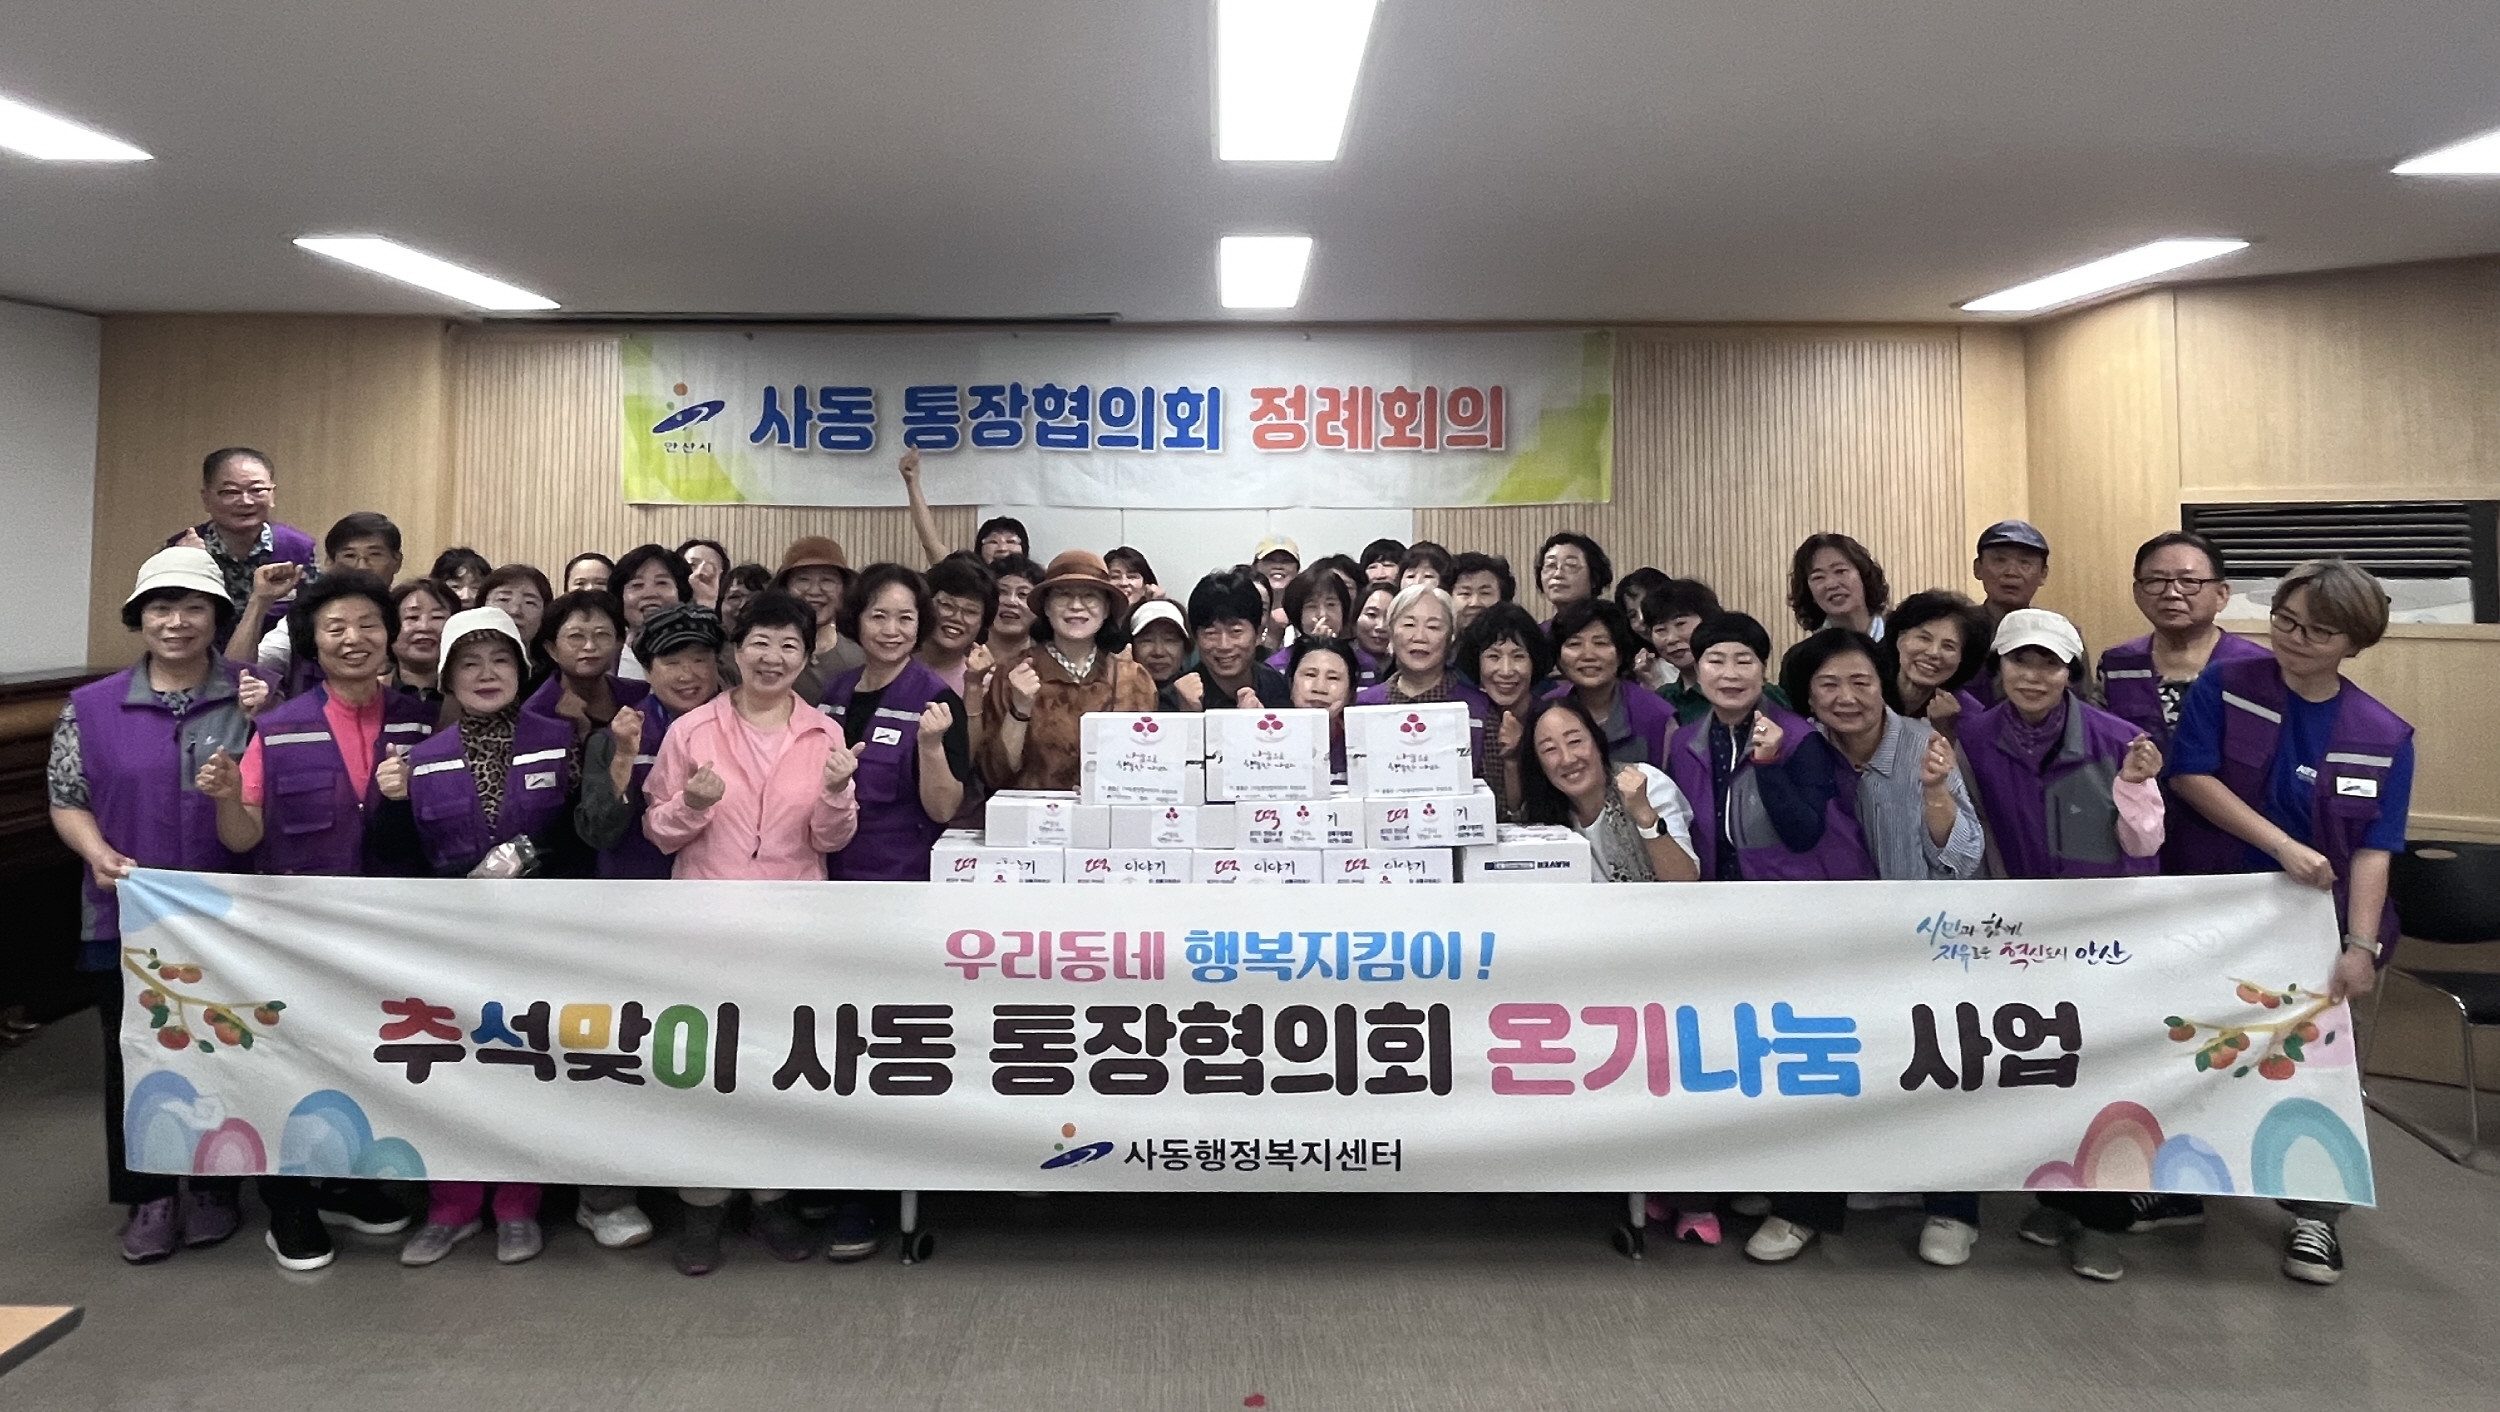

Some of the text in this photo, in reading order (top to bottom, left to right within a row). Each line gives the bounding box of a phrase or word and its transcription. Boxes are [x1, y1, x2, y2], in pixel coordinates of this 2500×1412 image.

[749, 381, 1504, 452] 사동 통장협의회 정례회의
[663, 441, 712, 454] 안산시
[1916, 911, 2023, 946] 시민과 함께
[943, 928, 1497, 983] 우리동네 행복지킴이!
[1931, 940, 2132, 973] 자유로운 혁신도시 안산
[373, 996, 2083, 1098] 추석맞이 사동 통장협의회 온기나눔 사업
[1123, 1137, 1403, 1174] 사동행정복지센터
